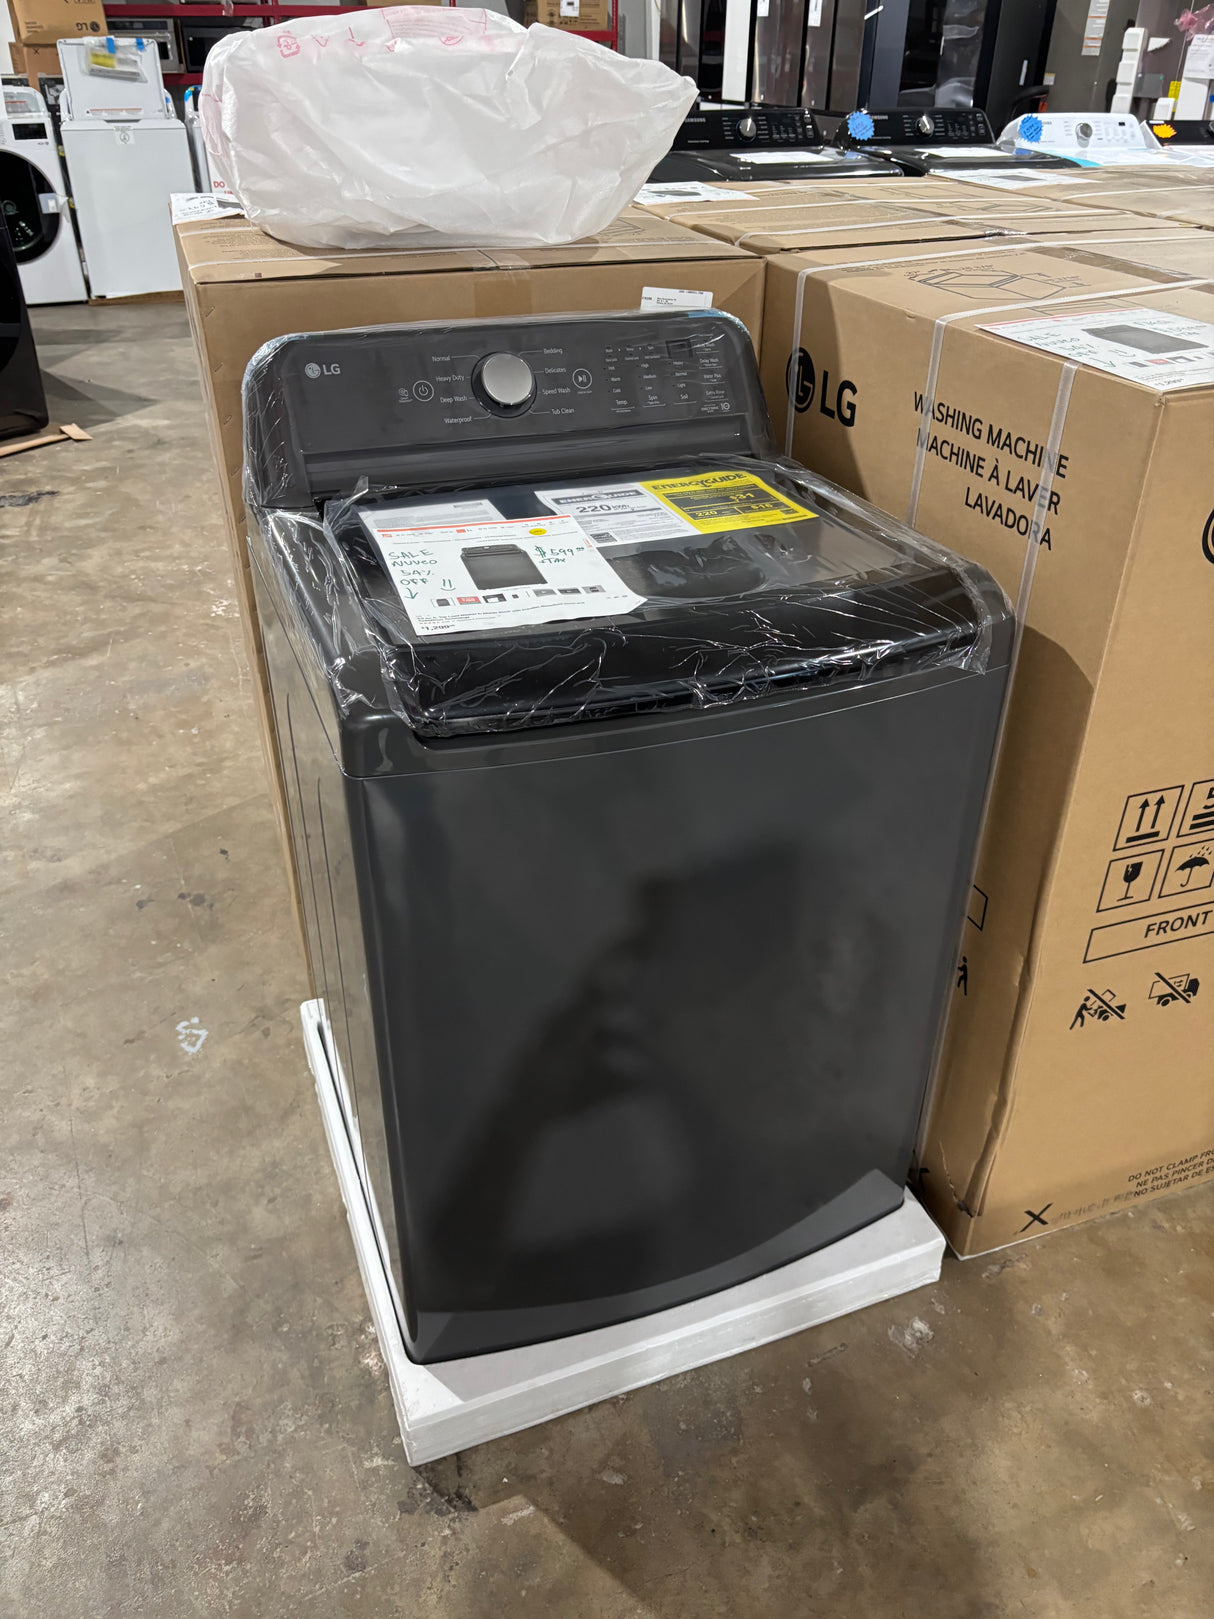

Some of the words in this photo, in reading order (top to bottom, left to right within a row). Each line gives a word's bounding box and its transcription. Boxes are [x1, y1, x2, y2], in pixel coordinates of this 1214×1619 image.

[323, 364, 341, 375] LG
[820, 370, 858, 428] LG
[444, 416, 472, 424] Waterproof
[914, 391, 983, 440] WASHING
[987, 424, 1070, 479] MACHINE
[917, 428, 986, 478] MACHINE
[988, 457, 1000, 486] À
[1005, 470, 1061, 515] LAVER
[576, 504, 612, 513] 220
[965, 487, 1052, 551] LAVADORA
[388, 549, 433, 560] SALE
[400, 577, 429, 585] OFF
[1144, 909, 1213, 938] FRONT
[1128, 1173, 1142, 1182] DO
[1144, 1165, 1164, 1177] NOT
[1166, 1155, 1198, 1171] CLAMP
[1136, 1179, 1149, 1188] NE
[1151, 1174, 1169, 1183] PAS
[1171, 1161, 1204, 1177] PINCER
[1133, 1188, 1148, 1197] NO
[1150, 1174, 1189, 1192] SUJETAR
[1191, 1169, 1203, 1178] DE
